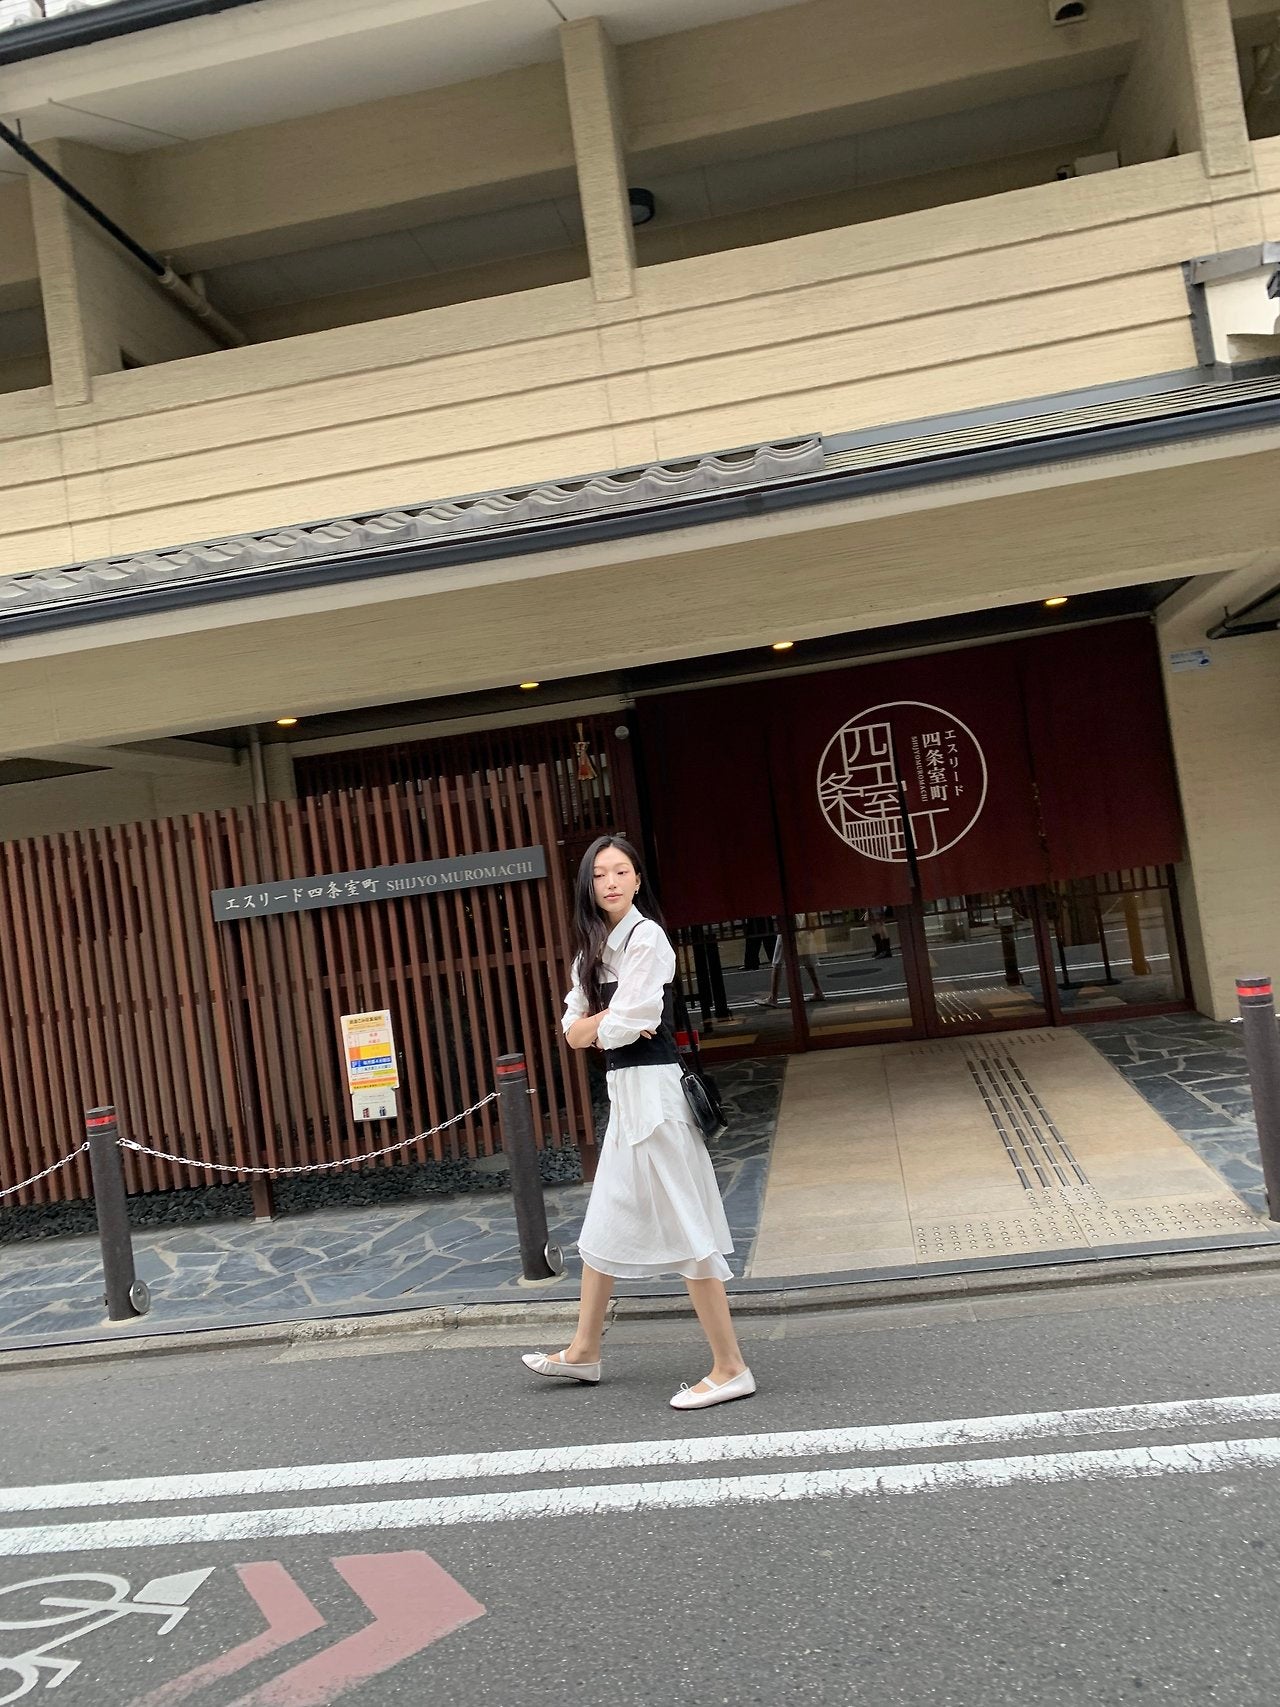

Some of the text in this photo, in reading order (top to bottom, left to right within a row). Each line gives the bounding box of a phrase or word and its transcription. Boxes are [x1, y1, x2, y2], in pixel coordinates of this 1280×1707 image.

[922, 731, 949, 801] 四条室町
[944, 729, 964, 797] エスリード
[225, 861, 533, 910] エスリード四条室町 SHIJYO MUROMACHI
